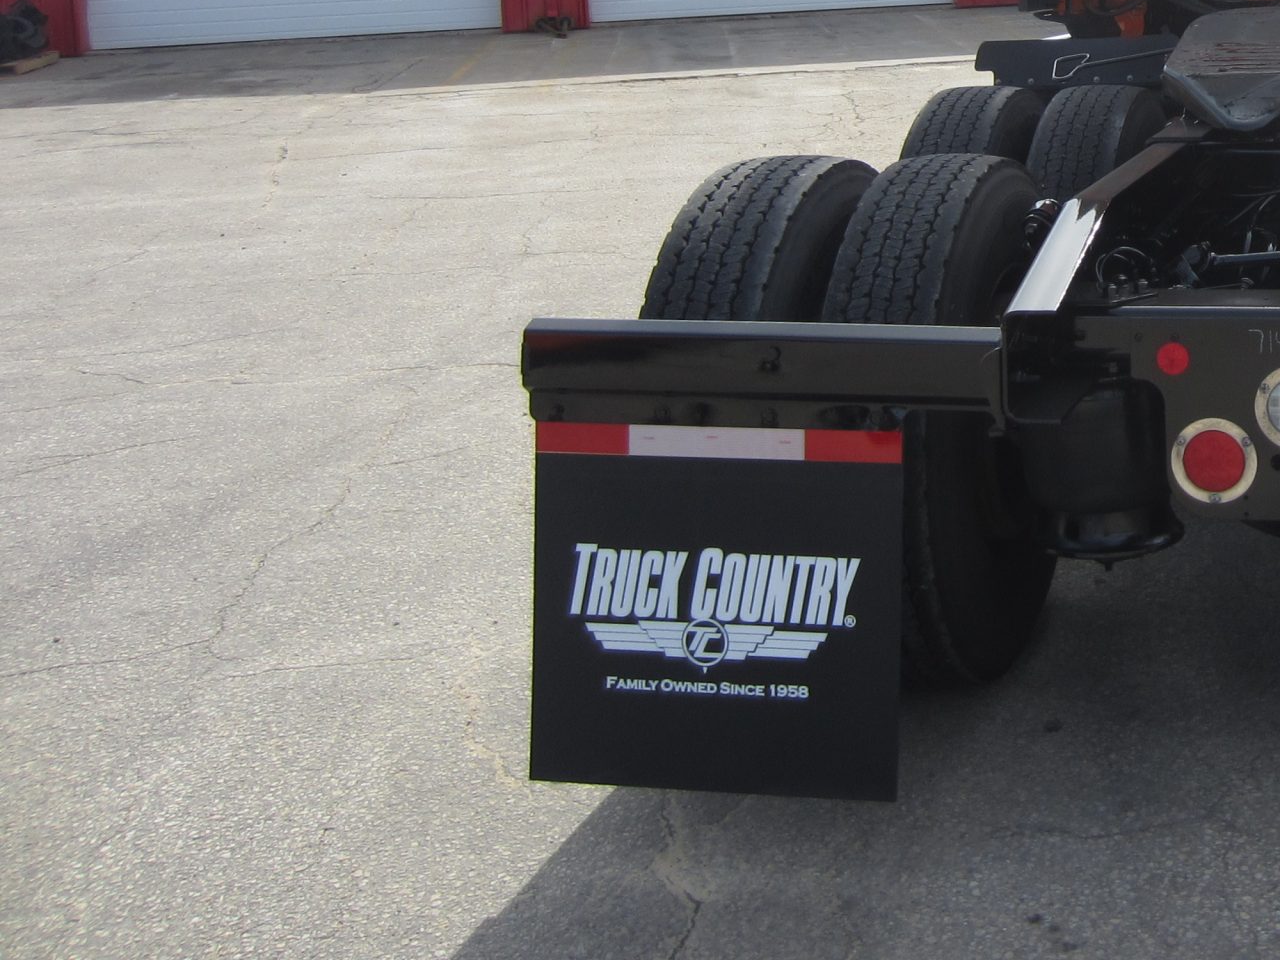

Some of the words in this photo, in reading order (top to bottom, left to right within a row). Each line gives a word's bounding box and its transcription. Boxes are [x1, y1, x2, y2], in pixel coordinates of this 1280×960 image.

[569, 542, 689, 620] TRUCK
[605, 675, 660, 692] FAMILY
[660, 678, 718, 695] OWNED
[719, 681, 766, 697] SINCE
[769, 683, 810, 699] 1958
